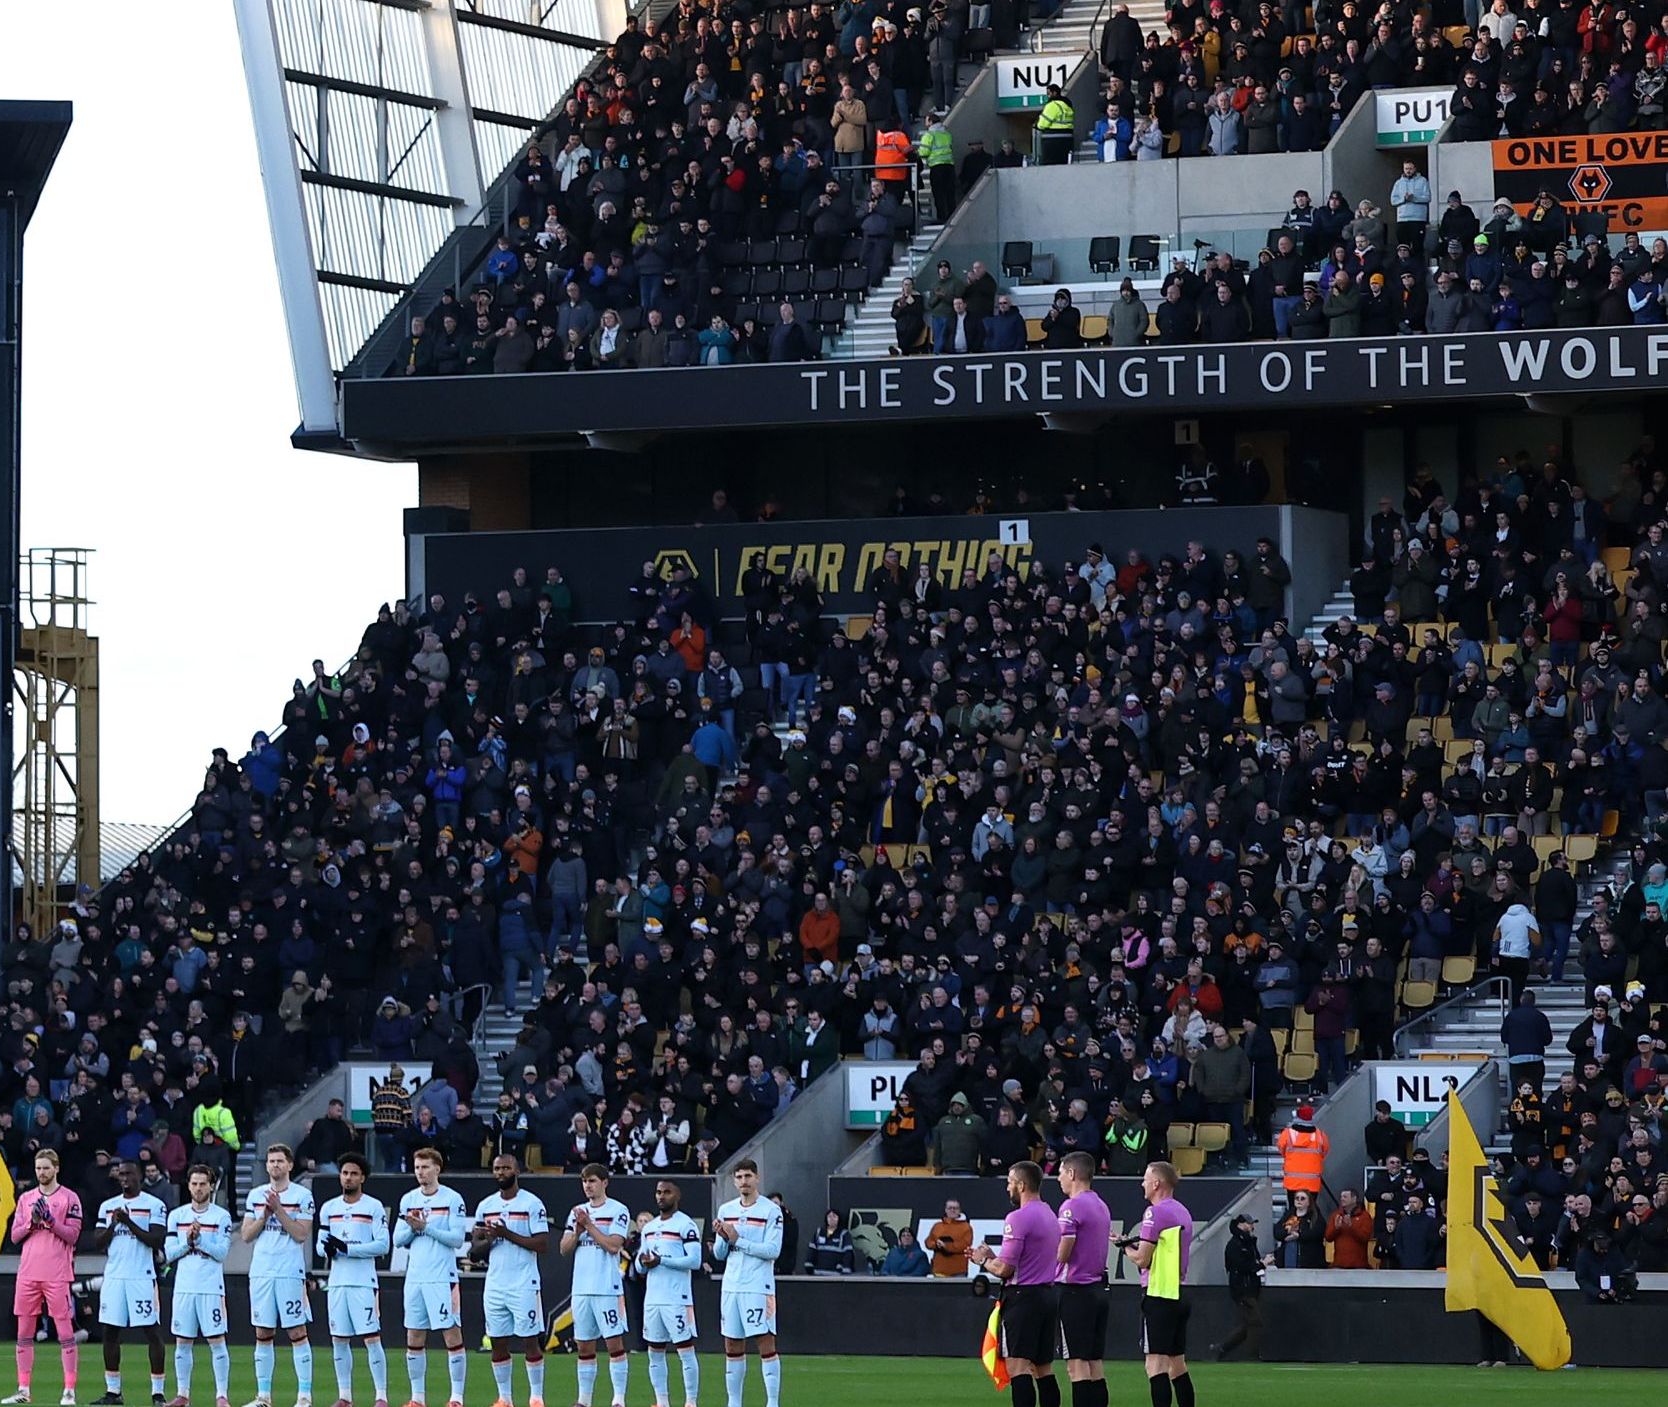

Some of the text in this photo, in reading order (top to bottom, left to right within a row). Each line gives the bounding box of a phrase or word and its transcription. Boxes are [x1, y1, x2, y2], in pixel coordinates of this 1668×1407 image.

[1013, 64, 1067, 89] NU1
[1395, 99, 1447, 124] PU1
[1507, 135, 1668, 166] ONE LOVE
[800, 334, 1668, 410] THE STRENGTH OF THE WOLF
[1182, 423, 1191, 442] 1
[1008, 522, 1018, 542] 1
[1397, 1075, 1458, 1102] NL2
[135, 1300, 152, 1315] 33
[212, 1308, 221, 1322] 8
[286, 1300, 302, 1315] 22
[364, 1307, 373, 1322] 7
[439, 1303, 448, 1316] 4
[527, 1309, 536, 1323] 9
[603, 1309, 618, 1325] 18
[675, 1315, 685, 1330] 3
[746, 1308, 763, 1323] 27
